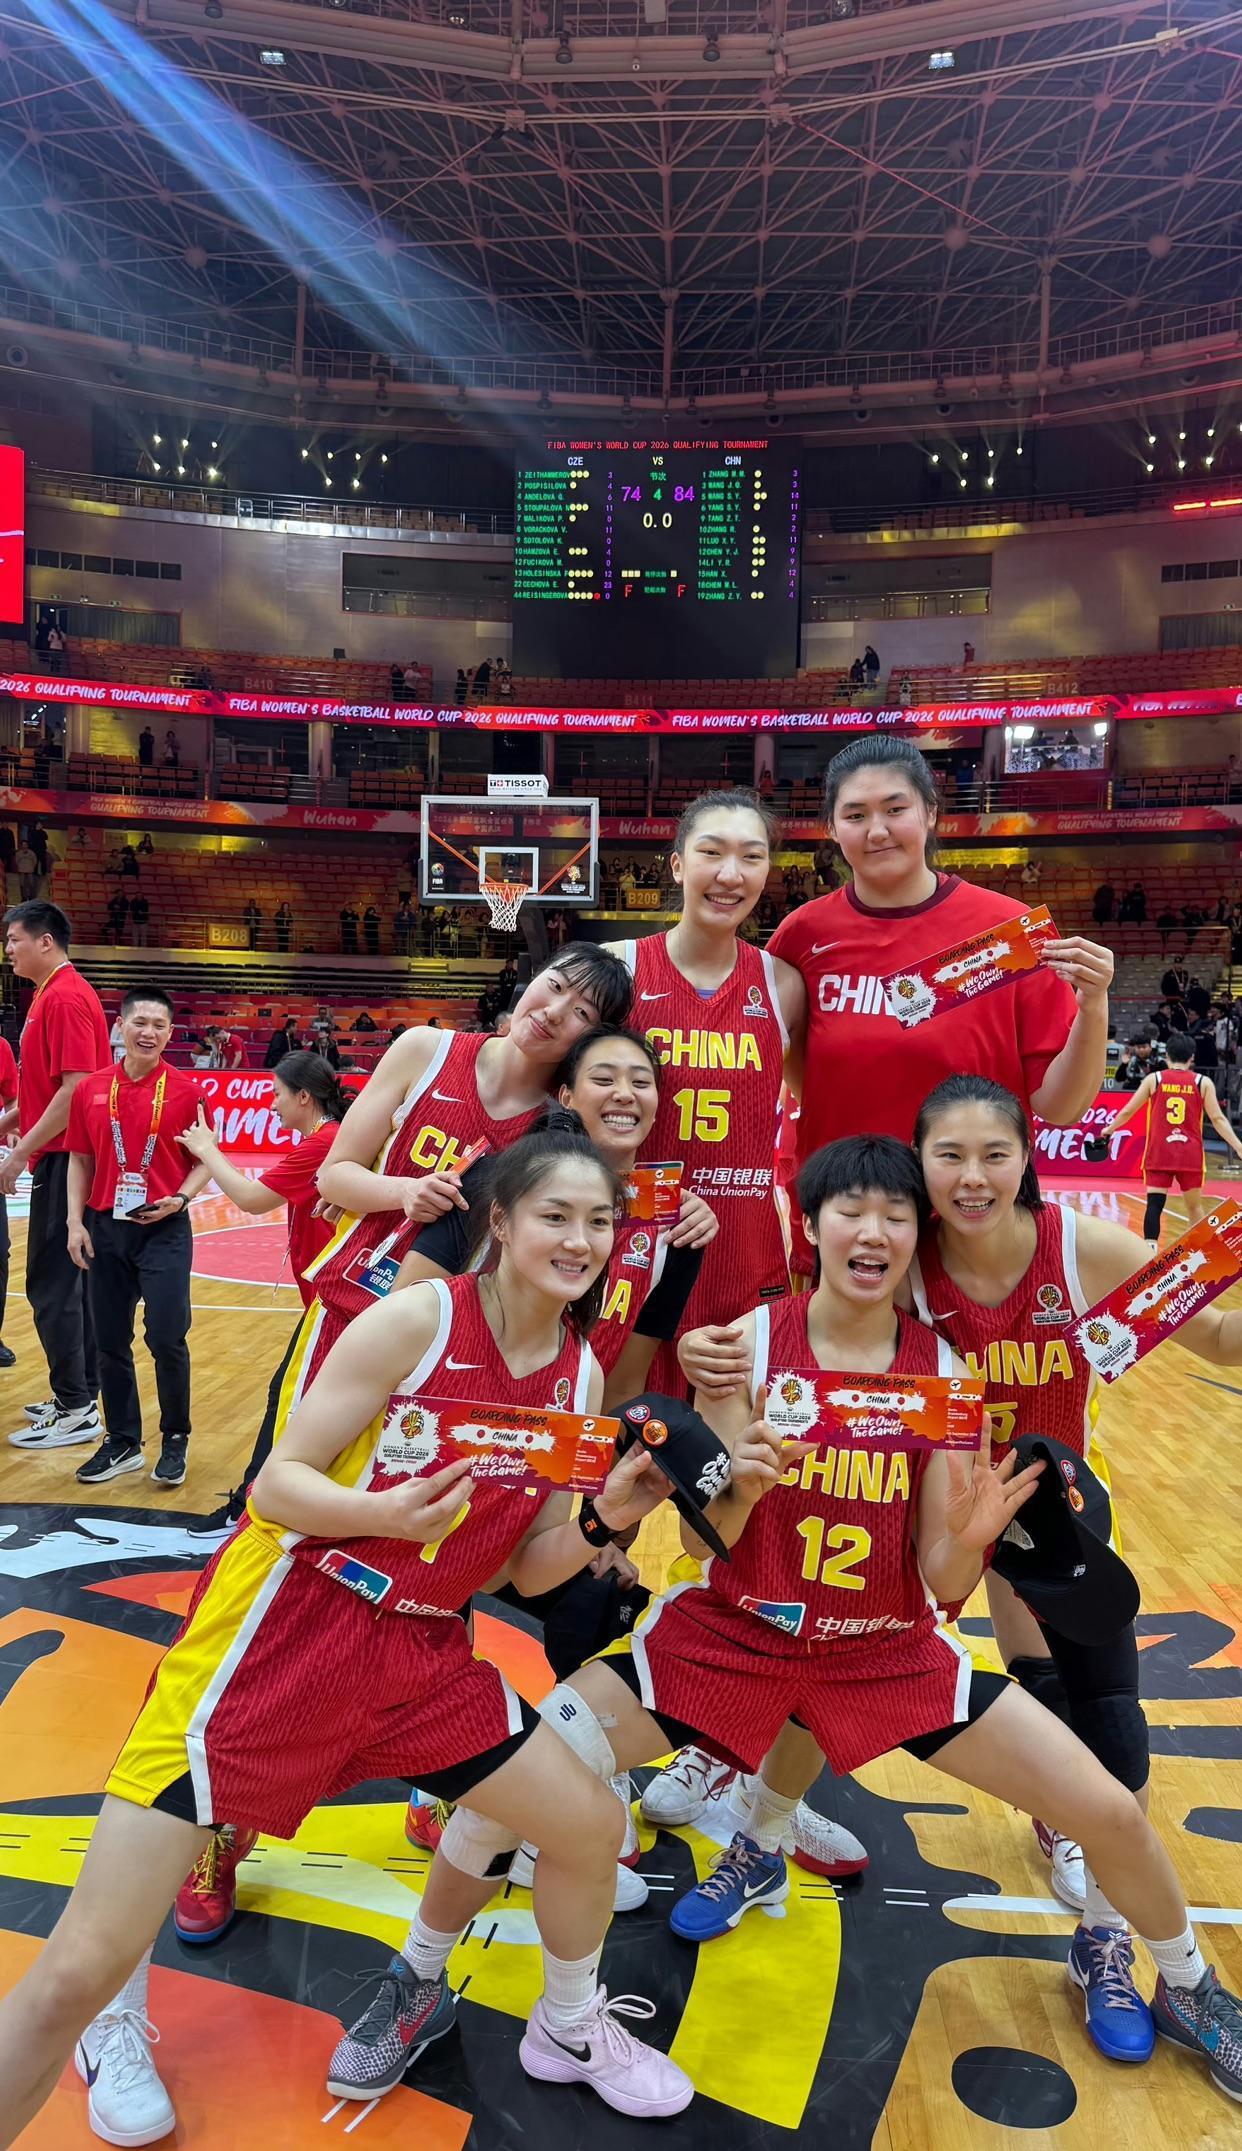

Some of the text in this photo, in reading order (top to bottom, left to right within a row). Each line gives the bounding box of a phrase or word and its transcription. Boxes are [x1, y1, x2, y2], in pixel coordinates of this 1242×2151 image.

[673, 441, 719, 449] QUALIFYING
[723, 440, 768, 448] TOURNAMENT
[567, 456, 584, 466] CZE
[652, 456, 664, 465] VS
[725, 456, 742, 465] CHN
[621, 486, 642, 502] 74
[653, 488, 662, 500] 4
[674, 486, 694, 502] 84
[642, 512, 672, 528] 0.0
[625, 584, 632, 598] F
[678, 584, 686, 598] F
[244, 677, 274, 690] B410
[1048, 682, 1079, 696] B412
[0, 680, 192, 706] 2026 QUALIFYING TOURNAMENT
[229, 698, 638, 727] FIBA WOMEN'S BASKETBALL WORLD CUP 2026 QUALIFYING TOURNAMENT
[672, 702, 1094, 728] FIBA WOMEN'S BASKETBALL WORLD CUP 2026 QUALIFYING TOURNAMENT
[90, 802, 144, 815] QUALIFYING
[147, 806, 209, 818] TOURNAMENT
[304, 810, 358, 826] Wuhan
[618, 820, 671, 836] Wuhan
[1057, 816, 1184, 830] QUALIFYING TOURNAMENT
[628, 892, 658, 904] B209
[212, 928, 248, 942] B208
[938, 933, 994, 964] BOARDING PASS
[963, 955, 982, 968] CHINA
[819, 974, 897, 1016] CHIN
[645, 1027, 762, 1071] CHINA
[226, 1078, 274, 1100] CUP
[1161, 1084, 1180, 1093] WANG
[672, 1088, 731, 1142] 15
[1080, 1108, 1118, 1124] 026
[1166, 1096, 1186, 1124] 3
[692, 1168, 773, 1186] 中国银联
[688, 1186, 768, 1200] China UnionPay
[1126, 1244, 1184, 1295] BOARDING PASS
[1156, 1273, 1178, 1292] CHINA
[964, 1339, 1074, 1386] HINA
[842, 1375, 916, 1388] BOARDING PASS
[866, 1396, 890, 1404] CHINA
[470, 1408, 548, 1426] BOARDING PASS
[492, 1432, 518, 1442] CHINA
[796, 1515, 872, 1591] 12
[320, 1563, 378, 1602] UnionPay
[743, 1604, 798, 1629] UnionPay
